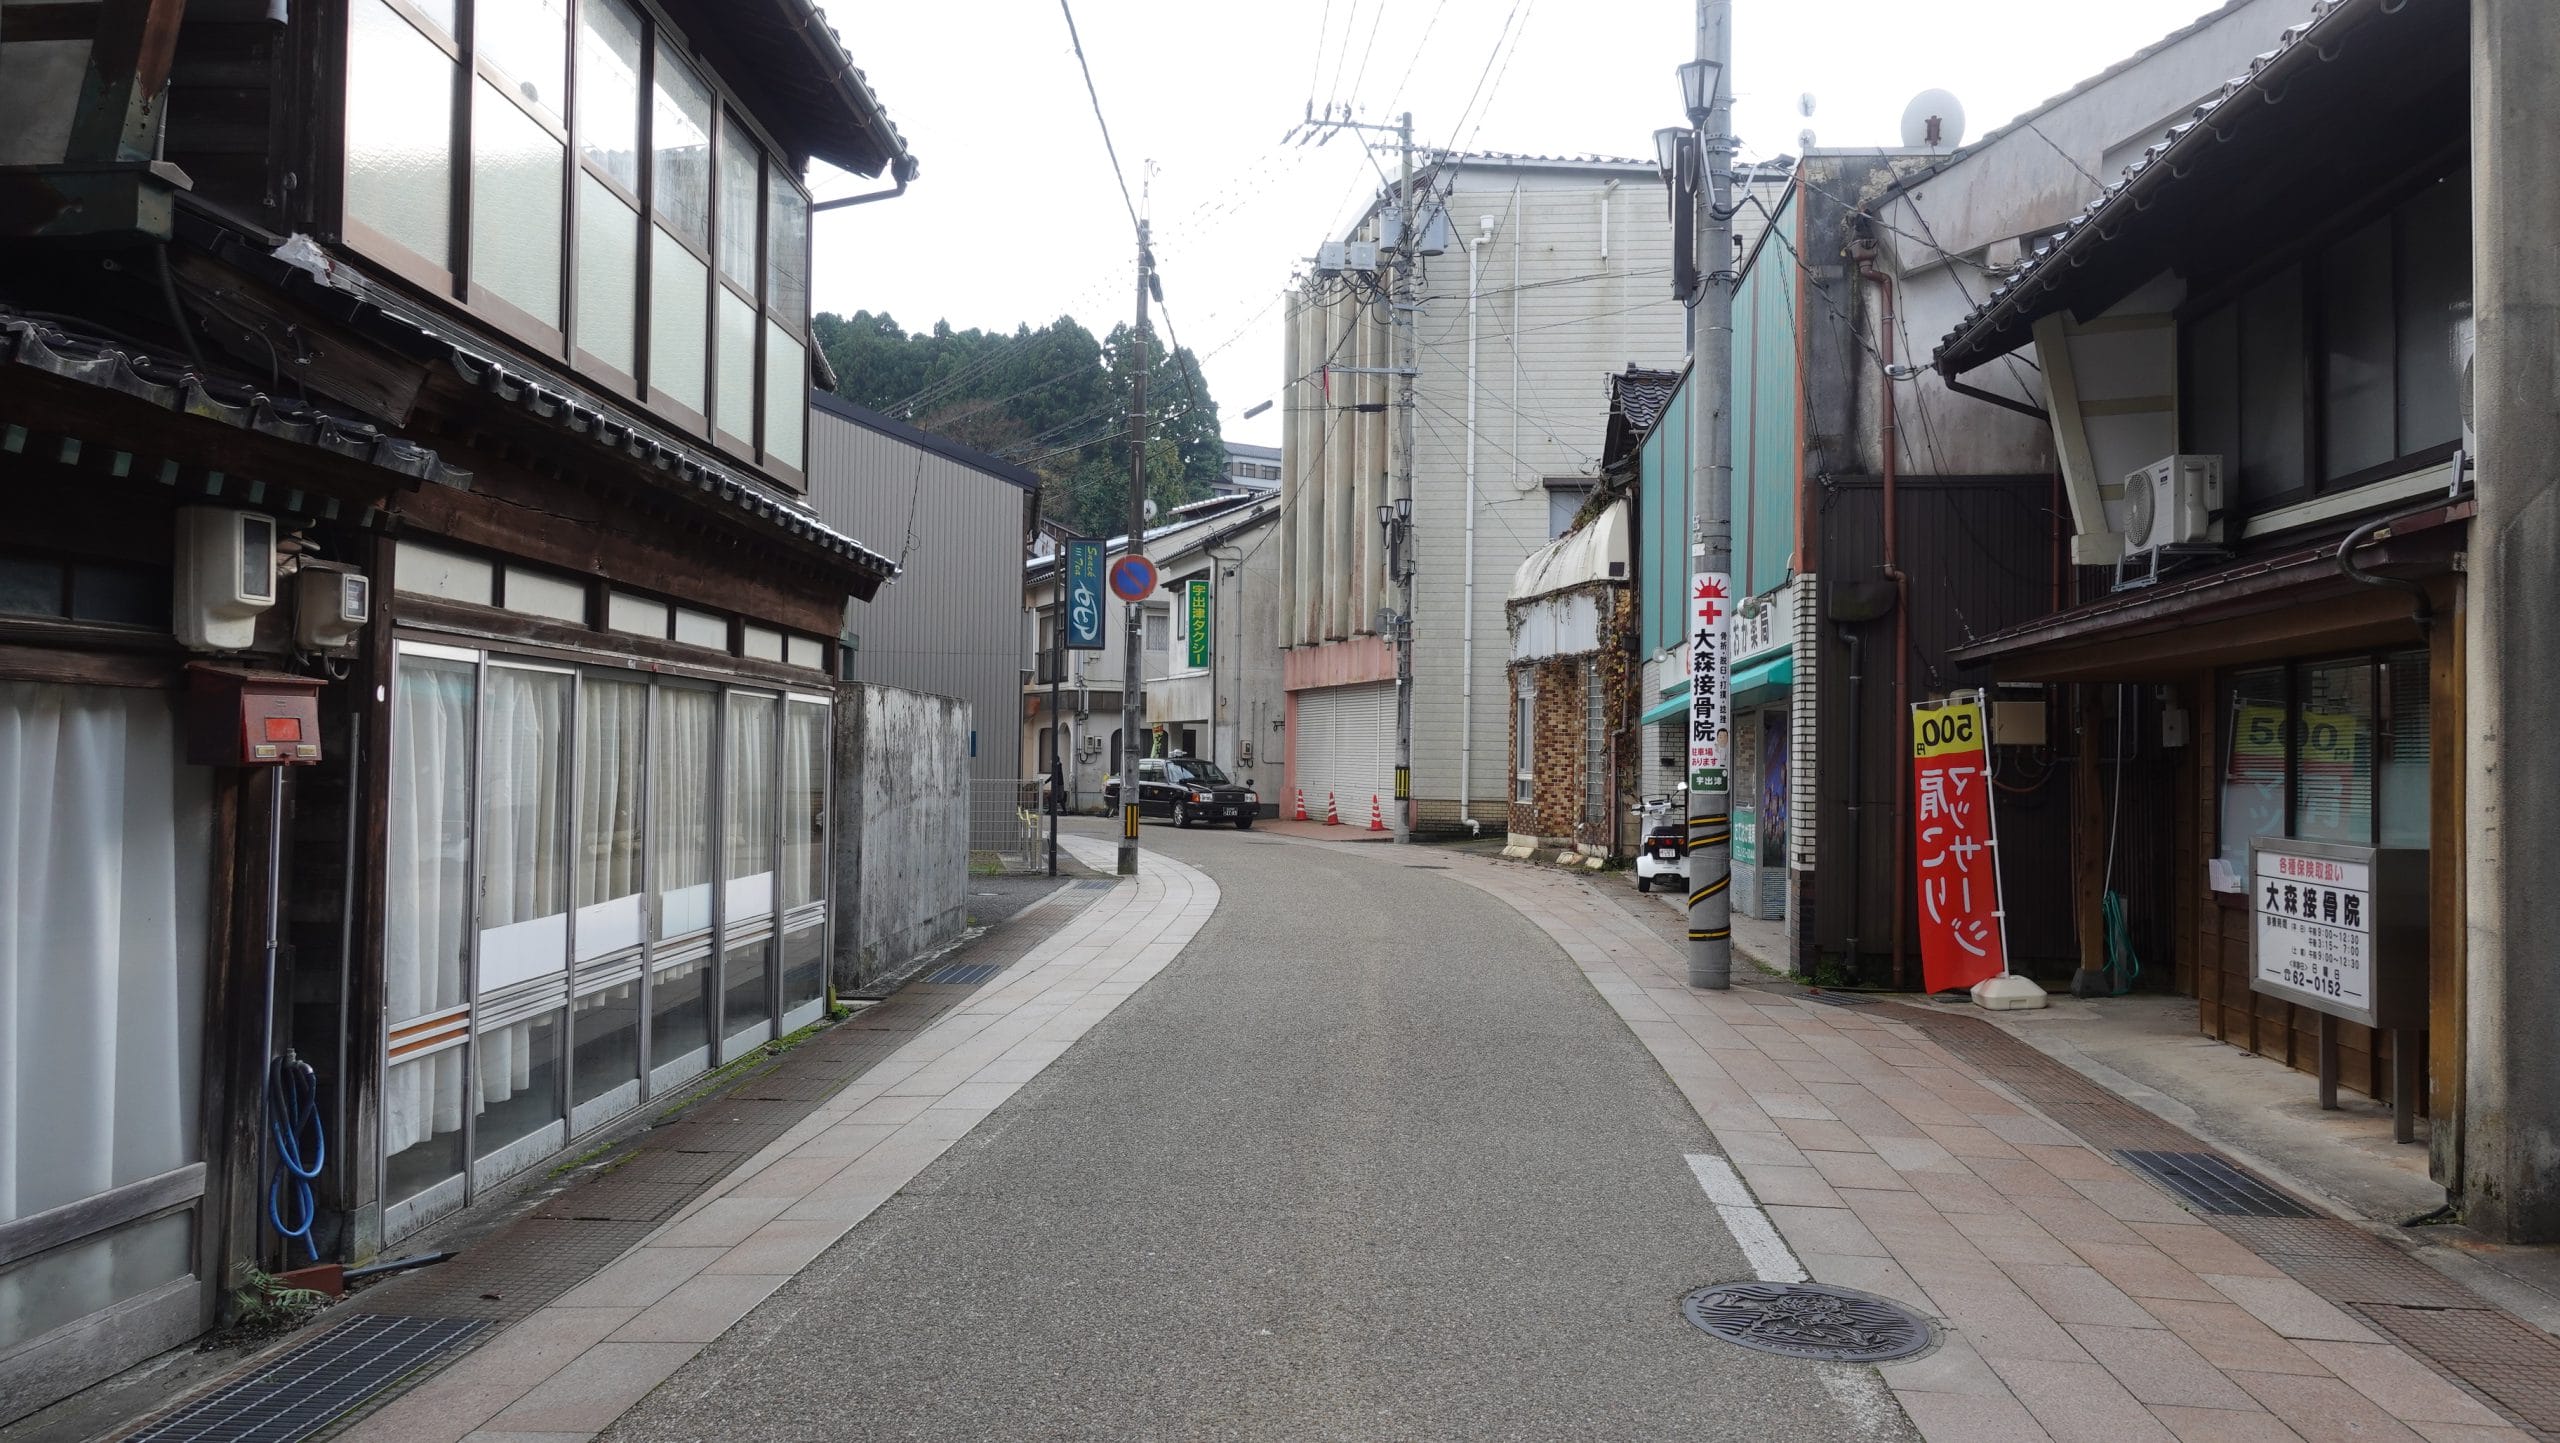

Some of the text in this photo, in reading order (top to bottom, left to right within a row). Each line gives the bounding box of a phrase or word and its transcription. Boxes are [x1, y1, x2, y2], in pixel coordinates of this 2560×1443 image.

[1087, 545, 1098, 578] Snack
[1693, 628, 1716, 742] 大森接骨院
[1691, 757, 1719, 767] あります
[2279, 857, 2344, 881] 各種保険取扱い
[2266, 881, 2360, 927] 大森接骨院
[2293, 970, 2341, 997] 62-0152
